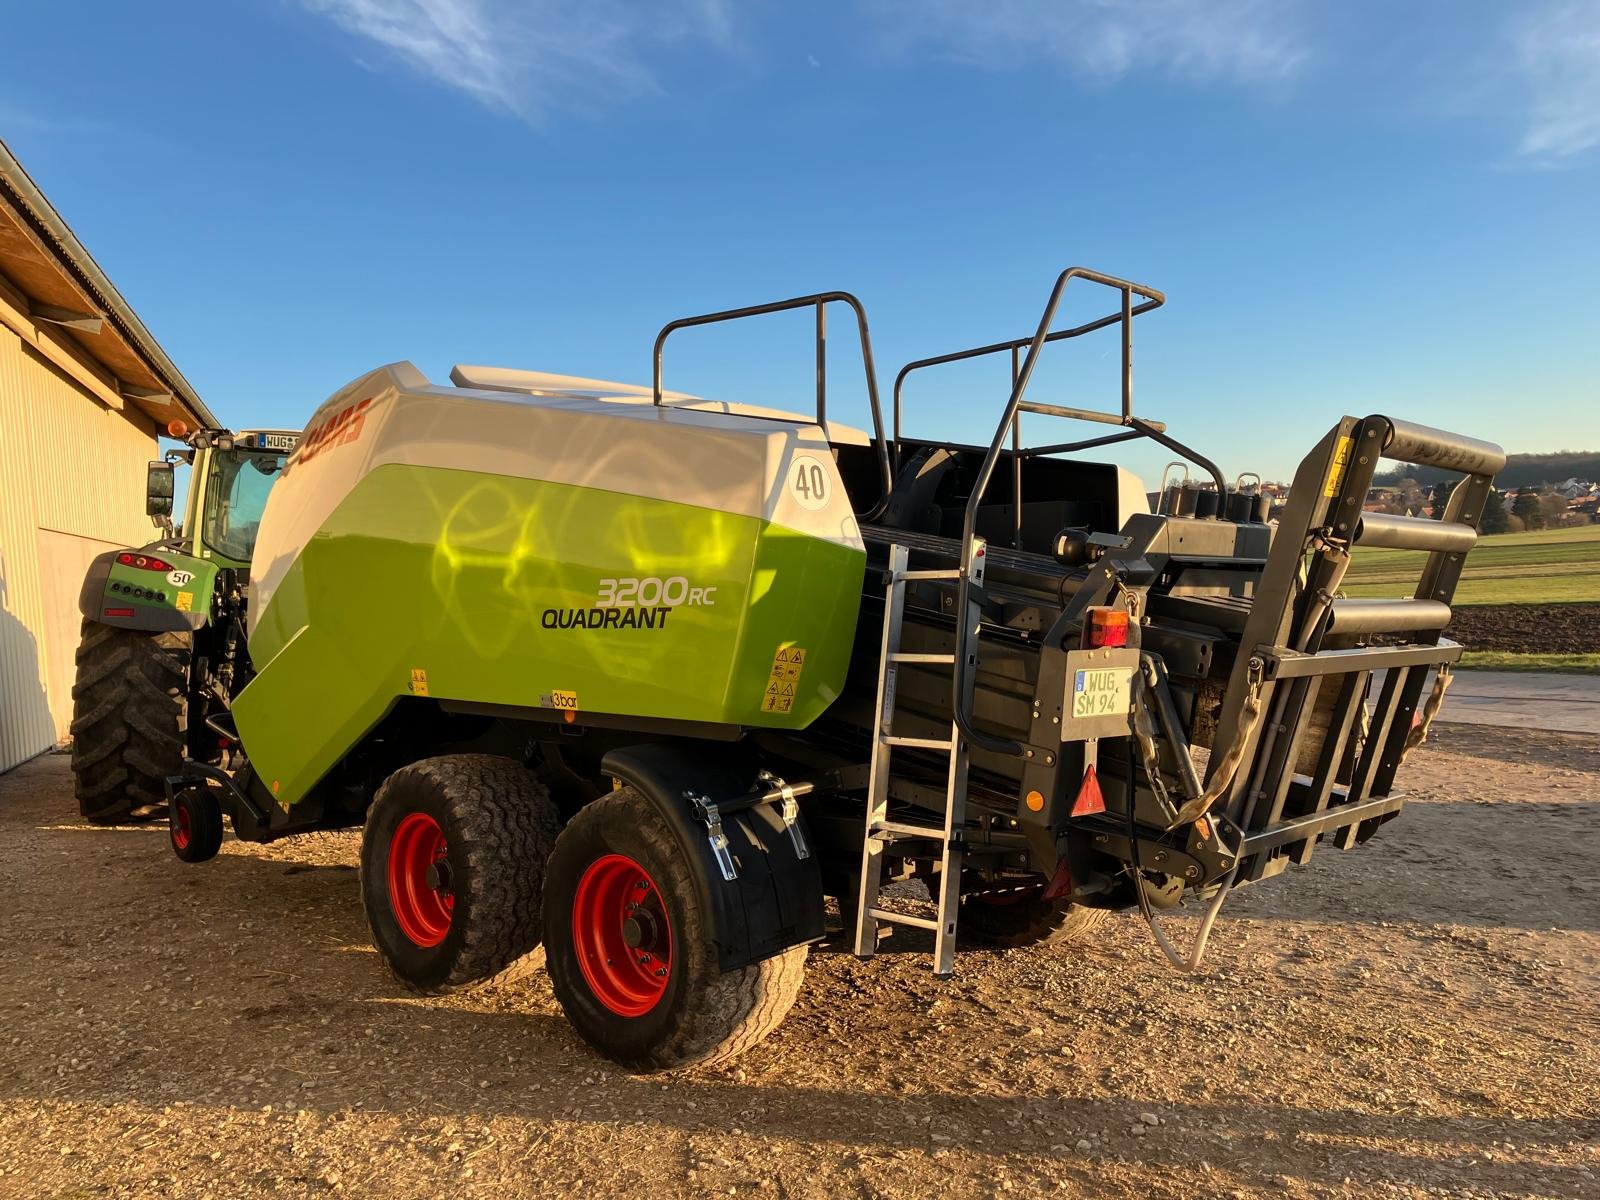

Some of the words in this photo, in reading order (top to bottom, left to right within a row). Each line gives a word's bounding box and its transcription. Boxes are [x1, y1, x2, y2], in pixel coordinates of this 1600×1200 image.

[267, 436, 287, 448] WUG
[795, 464, 825, 500] 40
[172, 572, 191, 585] 50
[596, 576, 689, 608] 3200
[688, 587, 717, 606] RC
[541, 607, 672, 629] QUADRANT
[1088, 672, 1116, 692] WUG
[1076, 694, 1096, 715] SM
[1099, 693, 1116, 714] 94
